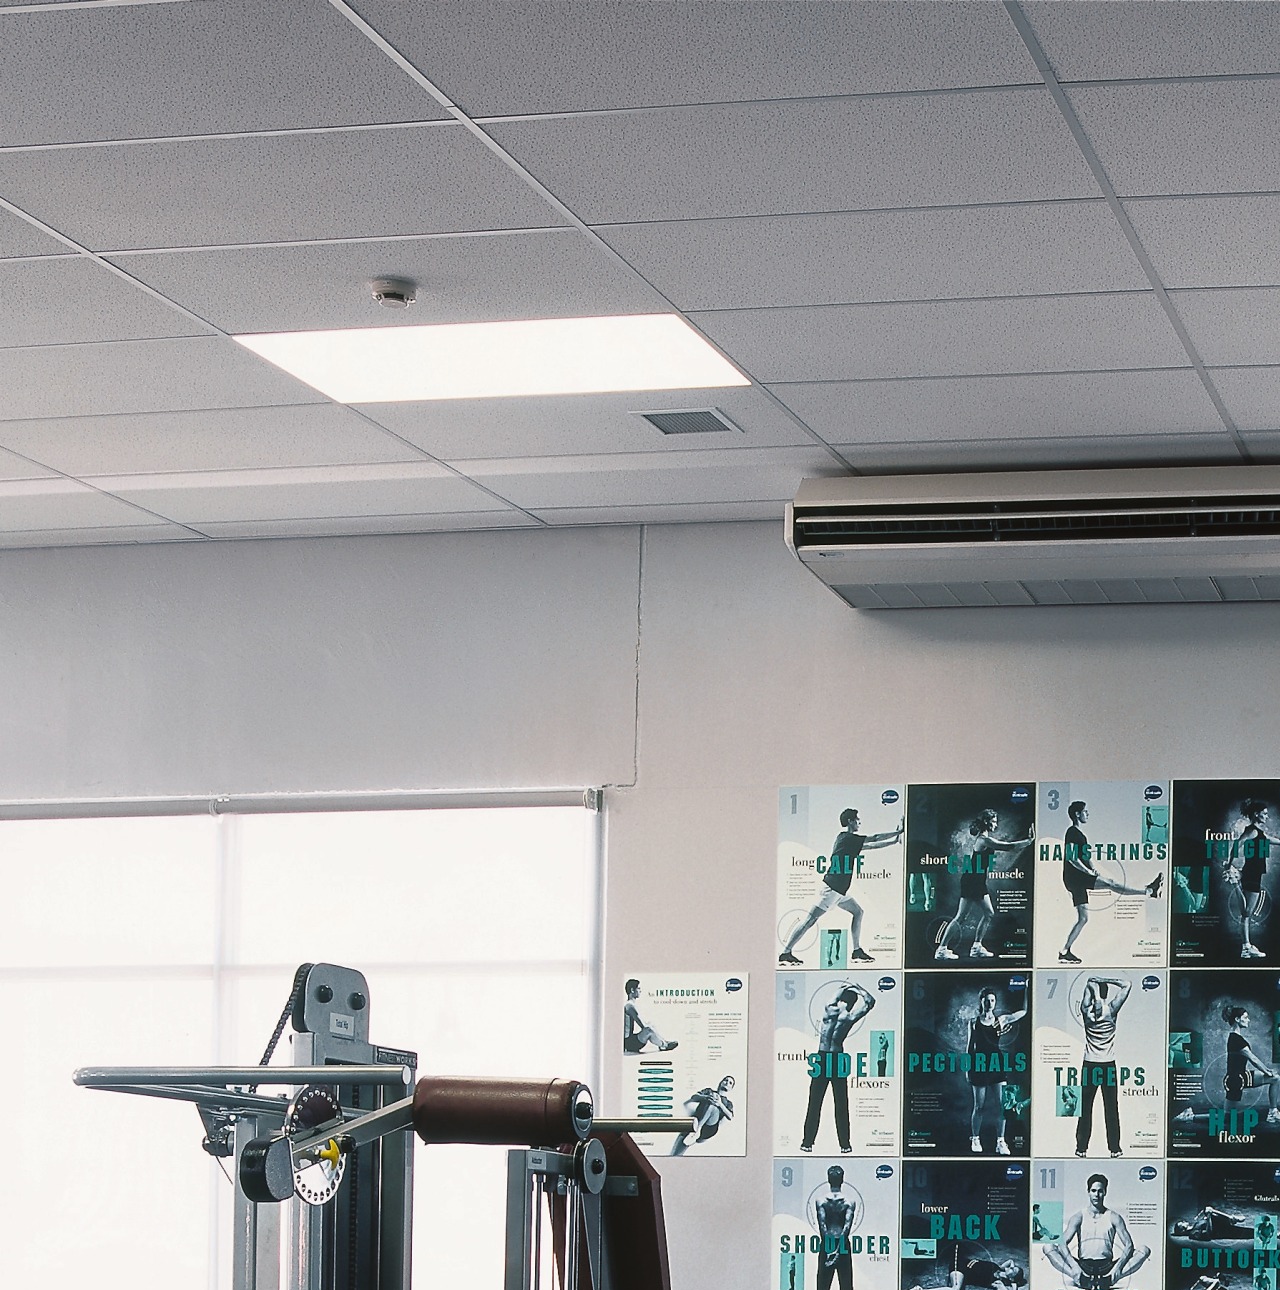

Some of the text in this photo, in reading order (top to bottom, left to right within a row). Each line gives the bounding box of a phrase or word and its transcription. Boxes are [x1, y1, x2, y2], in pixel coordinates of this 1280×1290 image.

[790, 794, 798, 815] 1
[1047, 789, 1060, 810] 3
[1204, 828, 1236, 841] front
[1039, 843, 1168, 861] HAMSTRINGS
[1204, 839, 1271, 859] THIGH
[791, 855, 866, 874] long CALF
[920, 853, 998, 874] short CALF
[988, 868, 1025, 879] muscle
[856, 869, 892, 880] muscle
[656, 989, 715, 997] INTRODUCTION
[783, 980, 796, 1001] 5
[912, 979, 925, 999] 6
[1046, 978, 1059, 999] 7
[777, 1050, 868, 1078] trunk SIDE
[908, 1052, 1027, 1073] PECTORALS
[850, 1077, 890, 1090] flexors
[1054, 1066, 1146, 1087] TRICEPS
[1122, 1085, 1159, 1097] stretch
[1208, 1108, 1259, 1136] HIP
[1218, 1131, 1256, 1144] flexor
[781, 1166, 794, 1187] 9
[1039, 1168, 1056, 1189] 11
[920, 1202, 949, 1213] lower
[930, 1214, 1001, 1240] BACK
[780, 1235, 890, 1254] SHOULDER
[869, 1253, 890, 1263] chest
